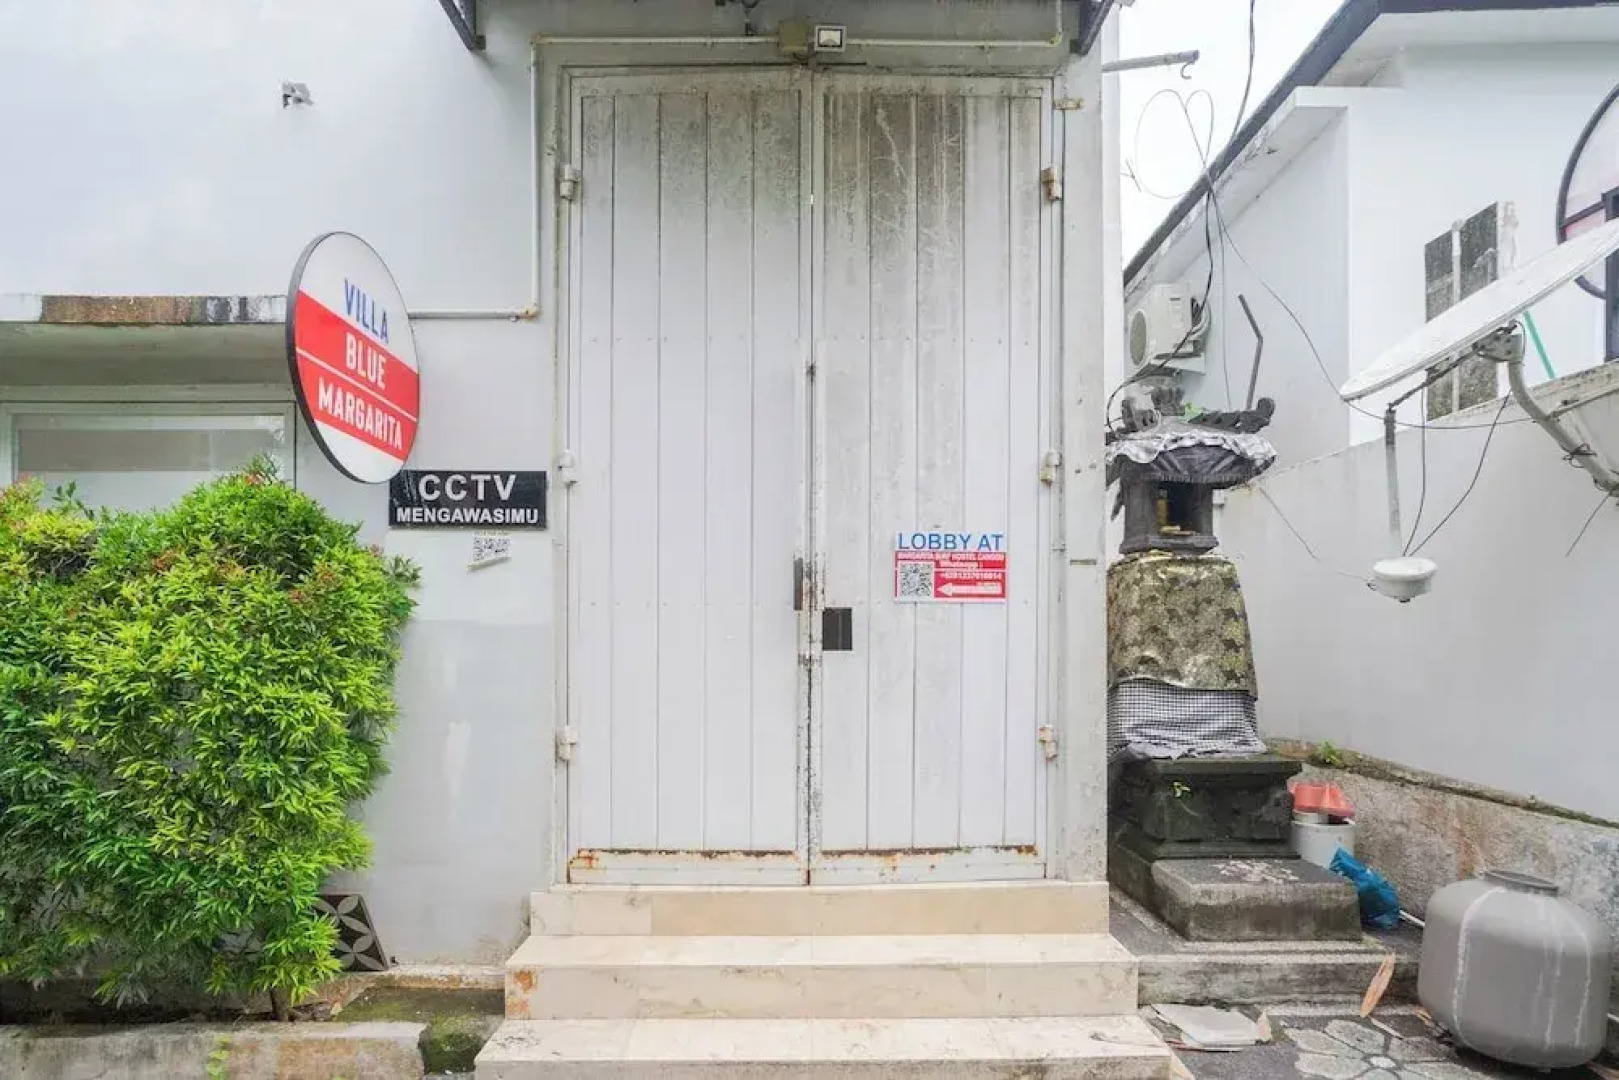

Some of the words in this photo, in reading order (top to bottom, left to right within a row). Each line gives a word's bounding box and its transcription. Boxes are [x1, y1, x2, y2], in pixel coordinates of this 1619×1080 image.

[343, 278, 390, 344] VILLA
[345, 333, 387, 390] BLUE
[318, 377, 403, 450] MARGARITA
[418, 473, 517, 502] CCTV
[396, 507, 539, 524] MENGAWASIMU
[898, 532, 972, 550] LOBBY
[977, 533, 1004, 551] AT
